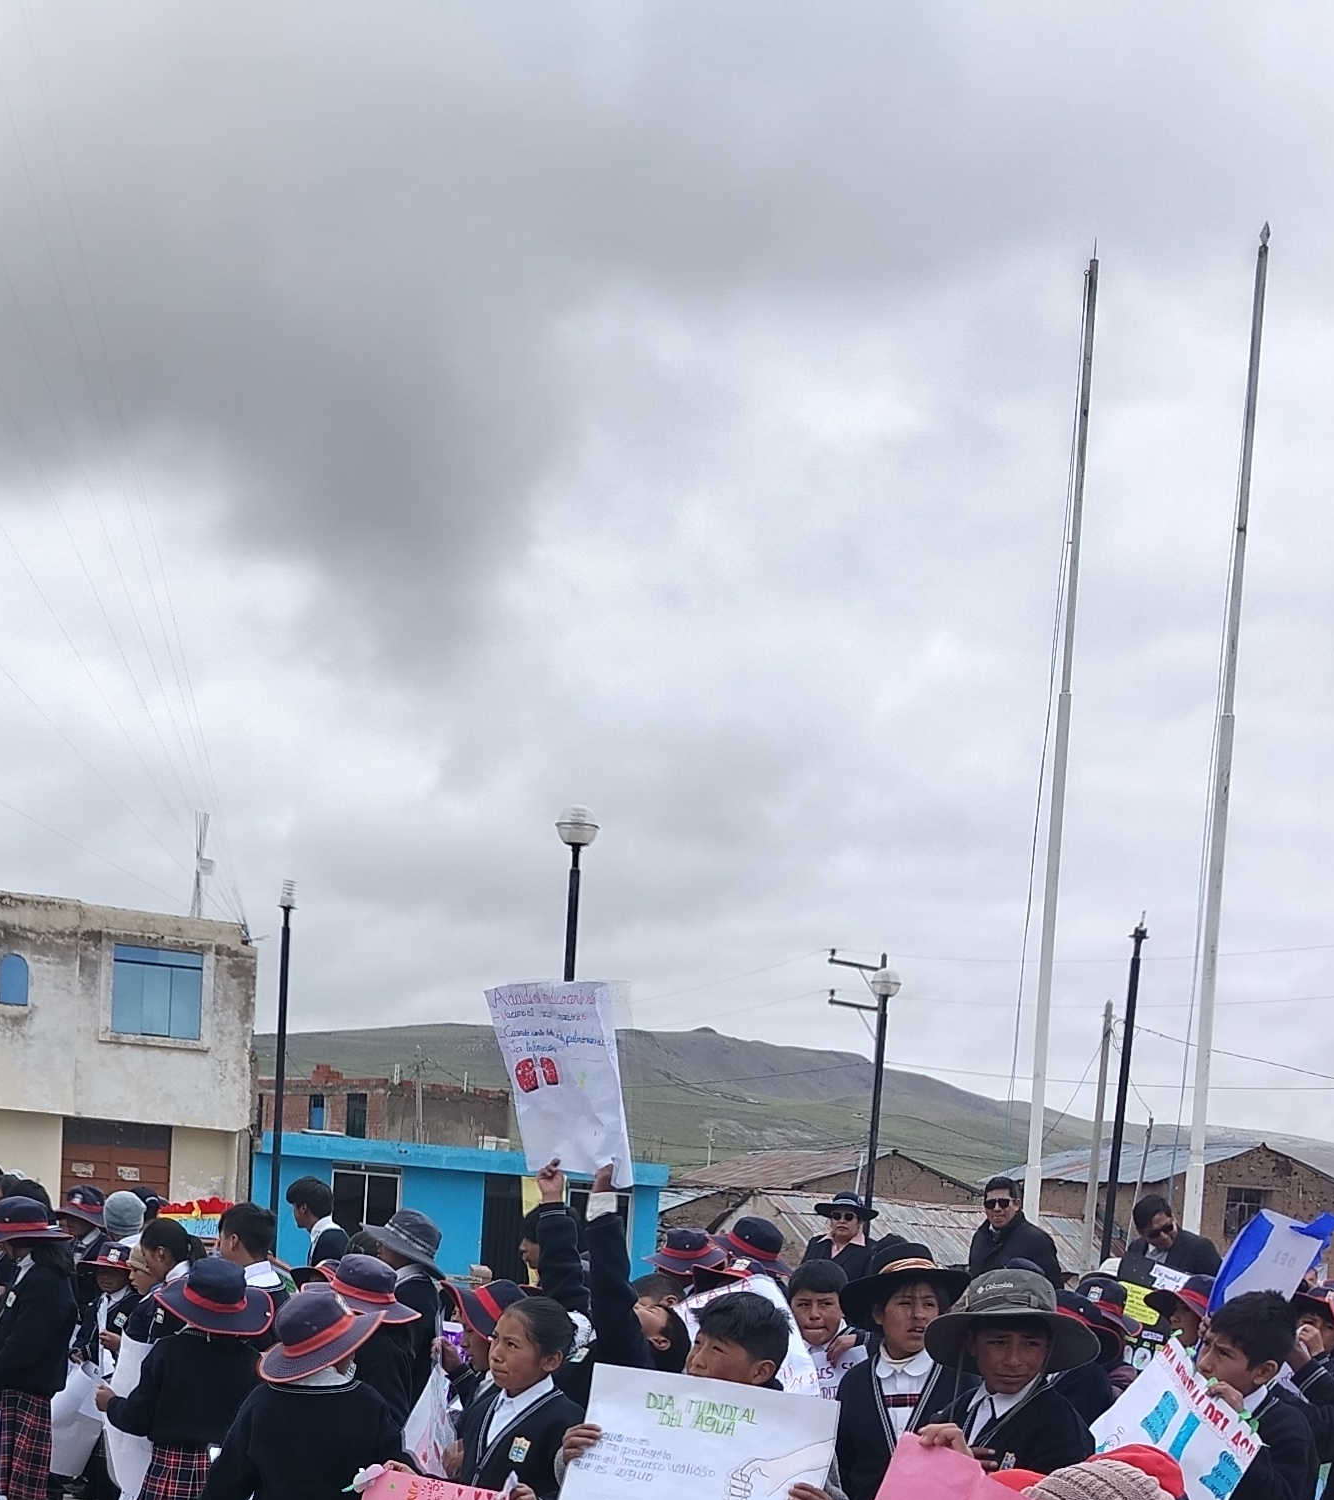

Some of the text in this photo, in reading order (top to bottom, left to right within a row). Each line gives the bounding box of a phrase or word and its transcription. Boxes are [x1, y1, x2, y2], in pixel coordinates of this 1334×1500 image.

[646, 1391, 758, 1425] DIA MUNDIAL
[657, 1411, 683, 1428] DEL
